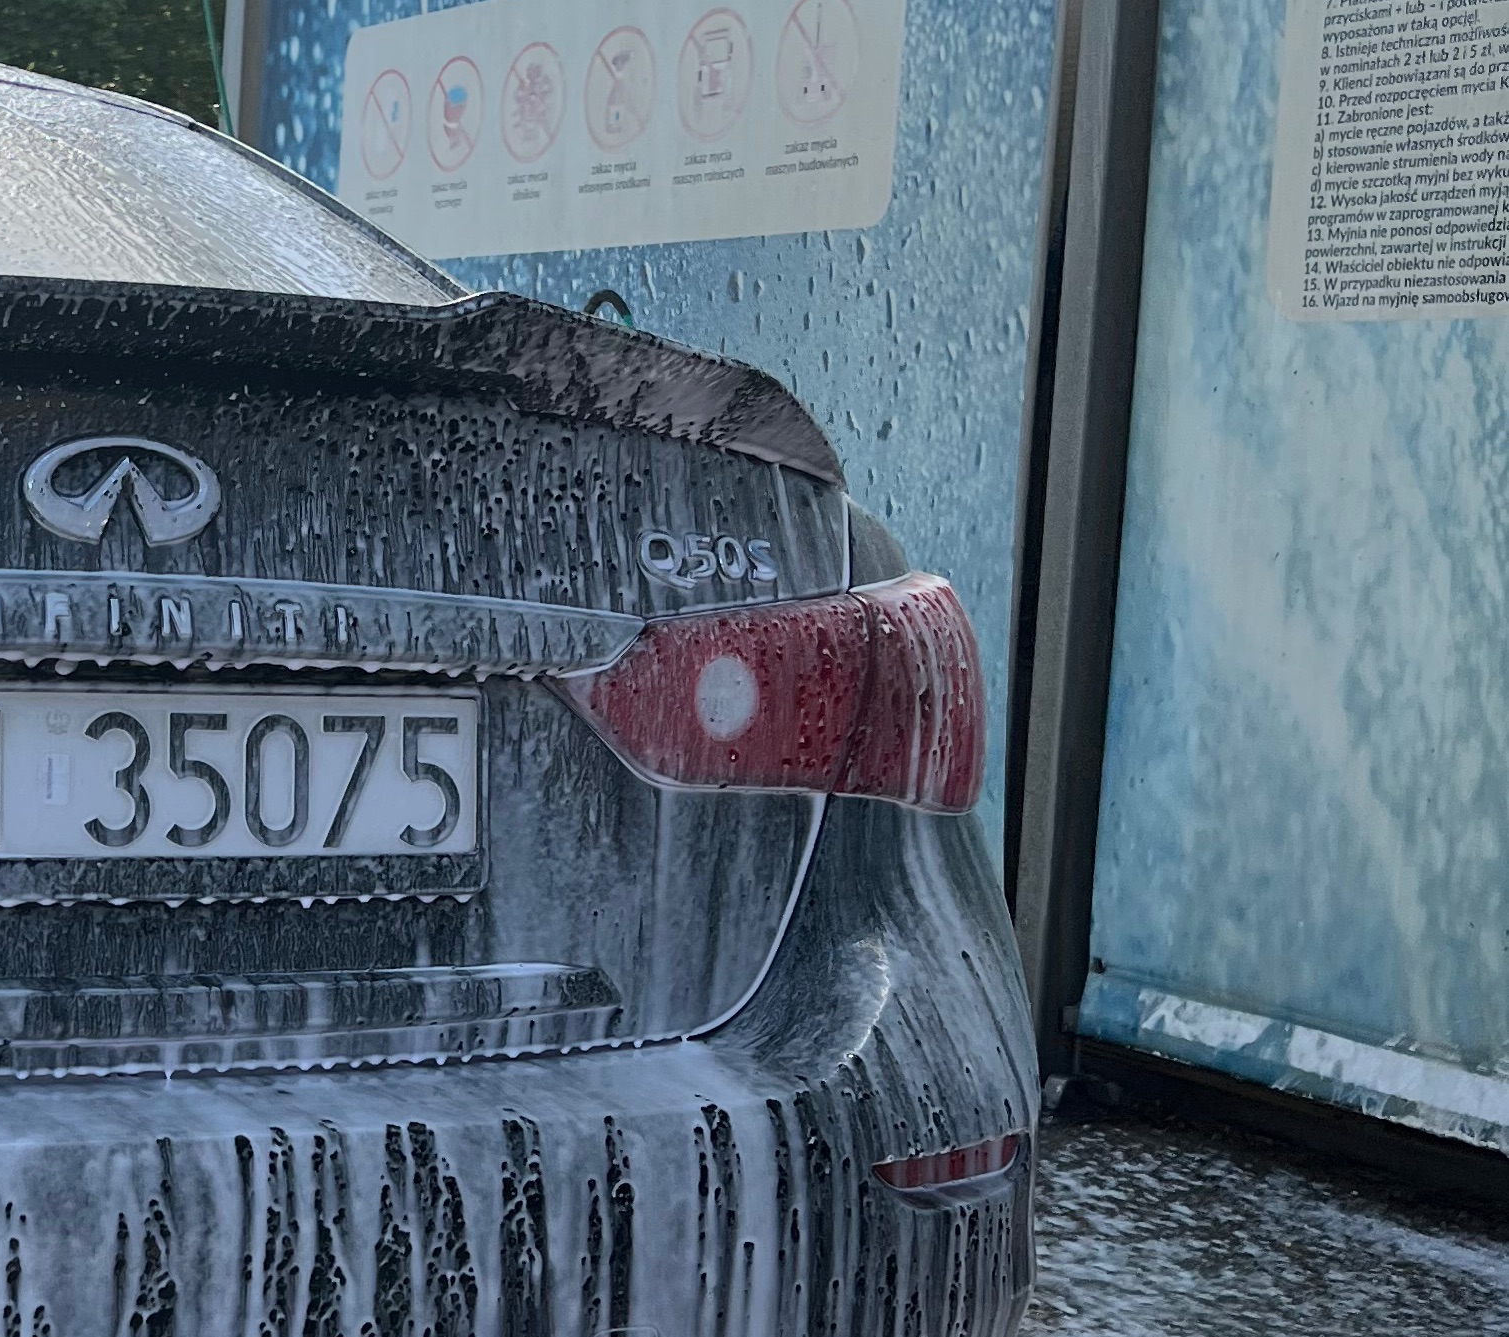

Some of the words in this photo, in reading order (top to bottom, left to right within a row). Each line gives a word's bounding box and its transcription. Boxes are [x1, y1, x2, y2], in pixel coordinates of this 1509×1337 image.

[1324, 5, 1391, 28] przyciskami
[1406, 1, 1424, 14] lub
[1323, 23, 1393, 44] wyposażona
[1398, 22, 1409, 32] w
[1411, 16, 1437, 30] taką
[1321, 46, 1332, 59] 8.
[1336, 42, 1377, 58] Istnieje
[1381, 34, 1445, 52] techniczna
[1320, 66, 1330, 75] w
[1334, 54, 1400, 74] nominałach
[1404, 53, 1411, 66] 2
[1415, 53, 1426, 64] zł
[1430, 50, 1448, 64] lub
[1453, 48, 1459, 60] 2
[1470, 45, 1477, 58] 5
[1319, 80, 1329, 92] 9.
[1334, 74, 1373, 90] Klienci
[1375, 65, 1450, 87] zobowiązani
[1454, 67, 1465, 79] są
[1470, 62, 1485, 75] do
[1318, 96, 1335, 109] 10.
[1339, 91, 1372, 107] Przed
[1375, 83, 1457, 104] rozpoczęciem
[1461, 80, 1496, 96] mycia
[1317, 113, 1334, 126] 11.
[1338, 106, 1404, 124] Zabronione
[1406, 104, 1433, 120] jest:
[1315, 129, 1324, 142] a)
[1329, 128, 1363, 142] mycie
[1367, 124, 1403, 140] ręczne
[1407, 116, 1469, 136] pojazdów,
[1473, 118, 1479, 127] a
[1314, 146, 1323, 159] b)
[1328, 140, 1392, 158] stosowanie
[1396, 135, 1453, 153] własnych
[1312, 163, 1321, 176] c)
[1326, 158, 1389, 175] kierowanie
[1393, 152, 1457, 169] strumienia
[1461, 149, 1494, 163] wody
[1311, 180, 1321, 194] d)
[1325, 177, 1359, 192] mycie
[1362, 170, 1411, 188] szczotką
[1415, 172, 1448, 187] myjni
[1453, 169, 1472, 181] bez
[1310, 197, 1327, 209] 12.
[1331, 192, 1376, 209] Wysoka
[1379, 189, 1417, 206] jakość
[1422, 187, 1475, 203] urządzeń
[1308, 210, 1373, 227] programów
[1377, 211, 1386, 220] w
[1390, 202, 1499, 221] zaprogramowanej
[1307, 229, 1324, 241] 13.
[1328, 227, 1367, 242] Myjnia
[1371, 226, 1387, 238] nie
[1391, 222, 1432, 238] ponosi
[1305, 242, 1377, 260] powierzchni,
[1381, 239, 1433, 255] zawartej
[1437, 241, 1446, 251] w
[1450, 235, 1507, 252] instrukcji
[1305, 263, 1321, 274] 14.
[1326, 259, 1383, 274] Właściciel
[1387, 258, 1433, 271] obiektu
[1438, 259, 1455, 269] nie
[1304, 279, 1320, 291] 15.
[1324, 278, 1338, 290] W
[1341, 276, 1400, 292] przypadku
[1404, 272, 1505, 287] niezastosowania
[1302, 296, 1318, 307] 16.
[1323, 293, 1358, 310] Wjazd
[1363, 296, 1375, 306] na
[1379, 291, 1418, 308] myjnię
[83, 710, 461, 848] 35075
